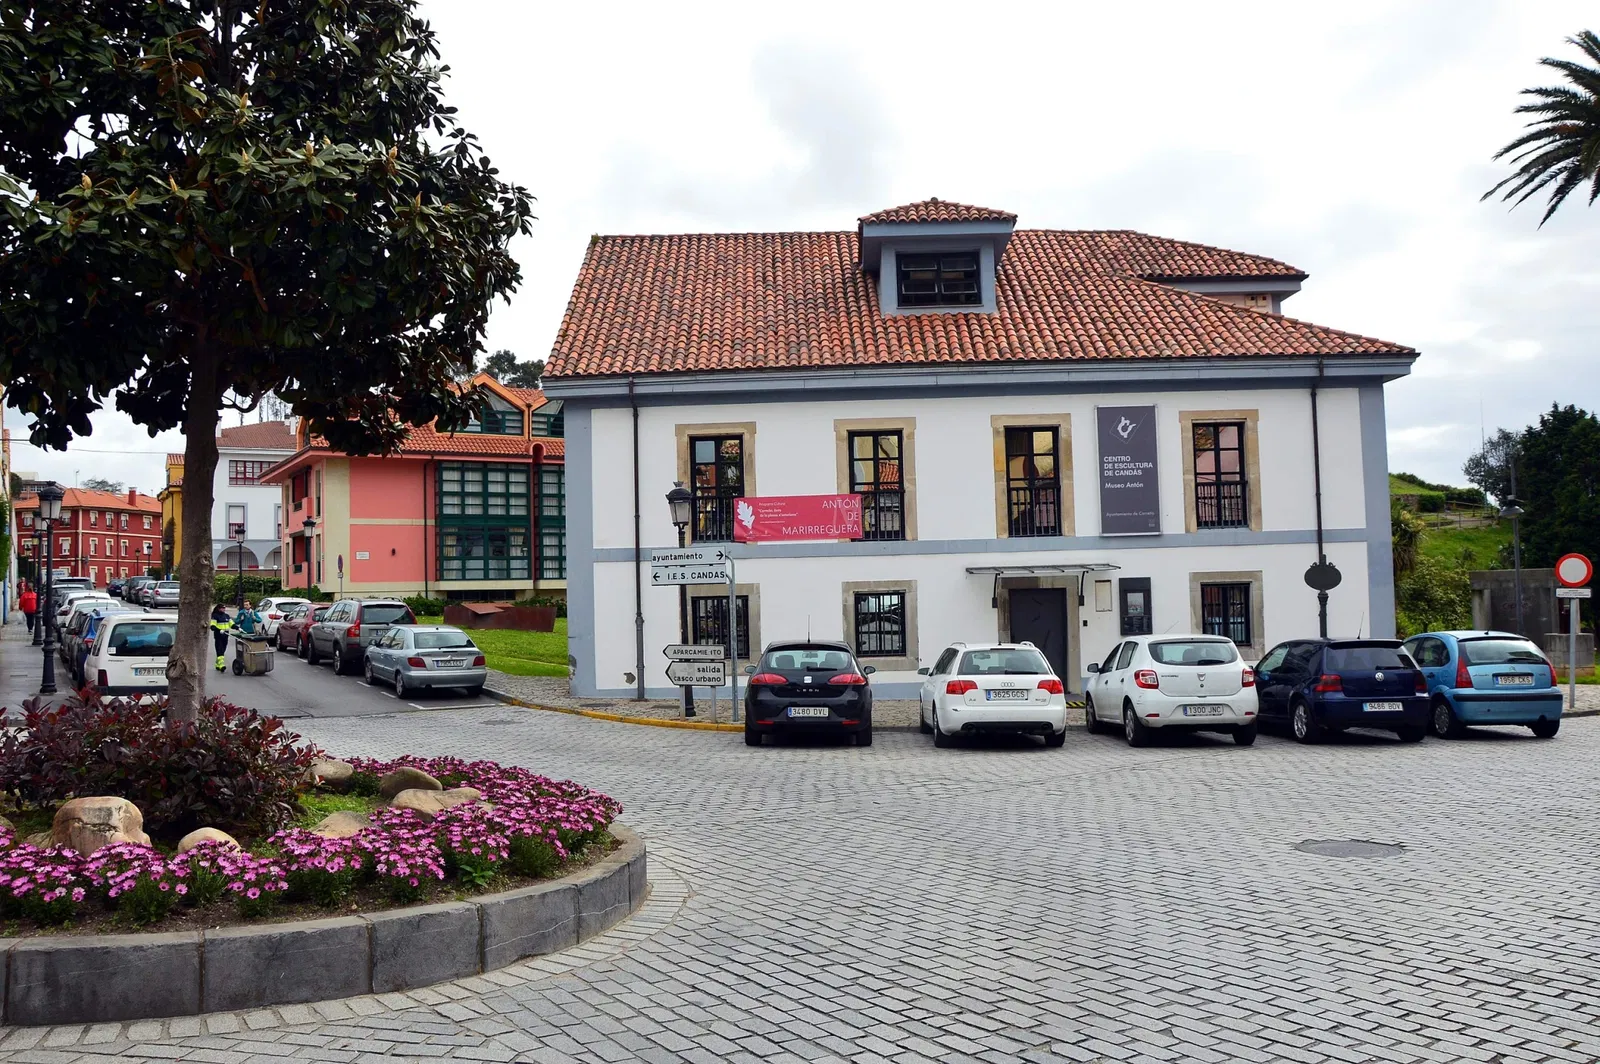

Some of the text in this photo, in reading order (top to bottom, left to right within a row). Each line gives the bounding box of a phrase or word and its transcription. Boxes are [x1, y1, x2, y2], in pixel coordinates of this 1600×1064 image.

[822, 497, 859, 509] ANTÓN
[847, 511, 859, 521] DE
[782, 524, 860, 535] MARIRREGUERA
[652, 552, 703, 562] ayuntamiento
[691, 571, 725, 580] CANDAS
[697, 665, 721, 673] salida
[1208, 705, 1221, 713] JNC
